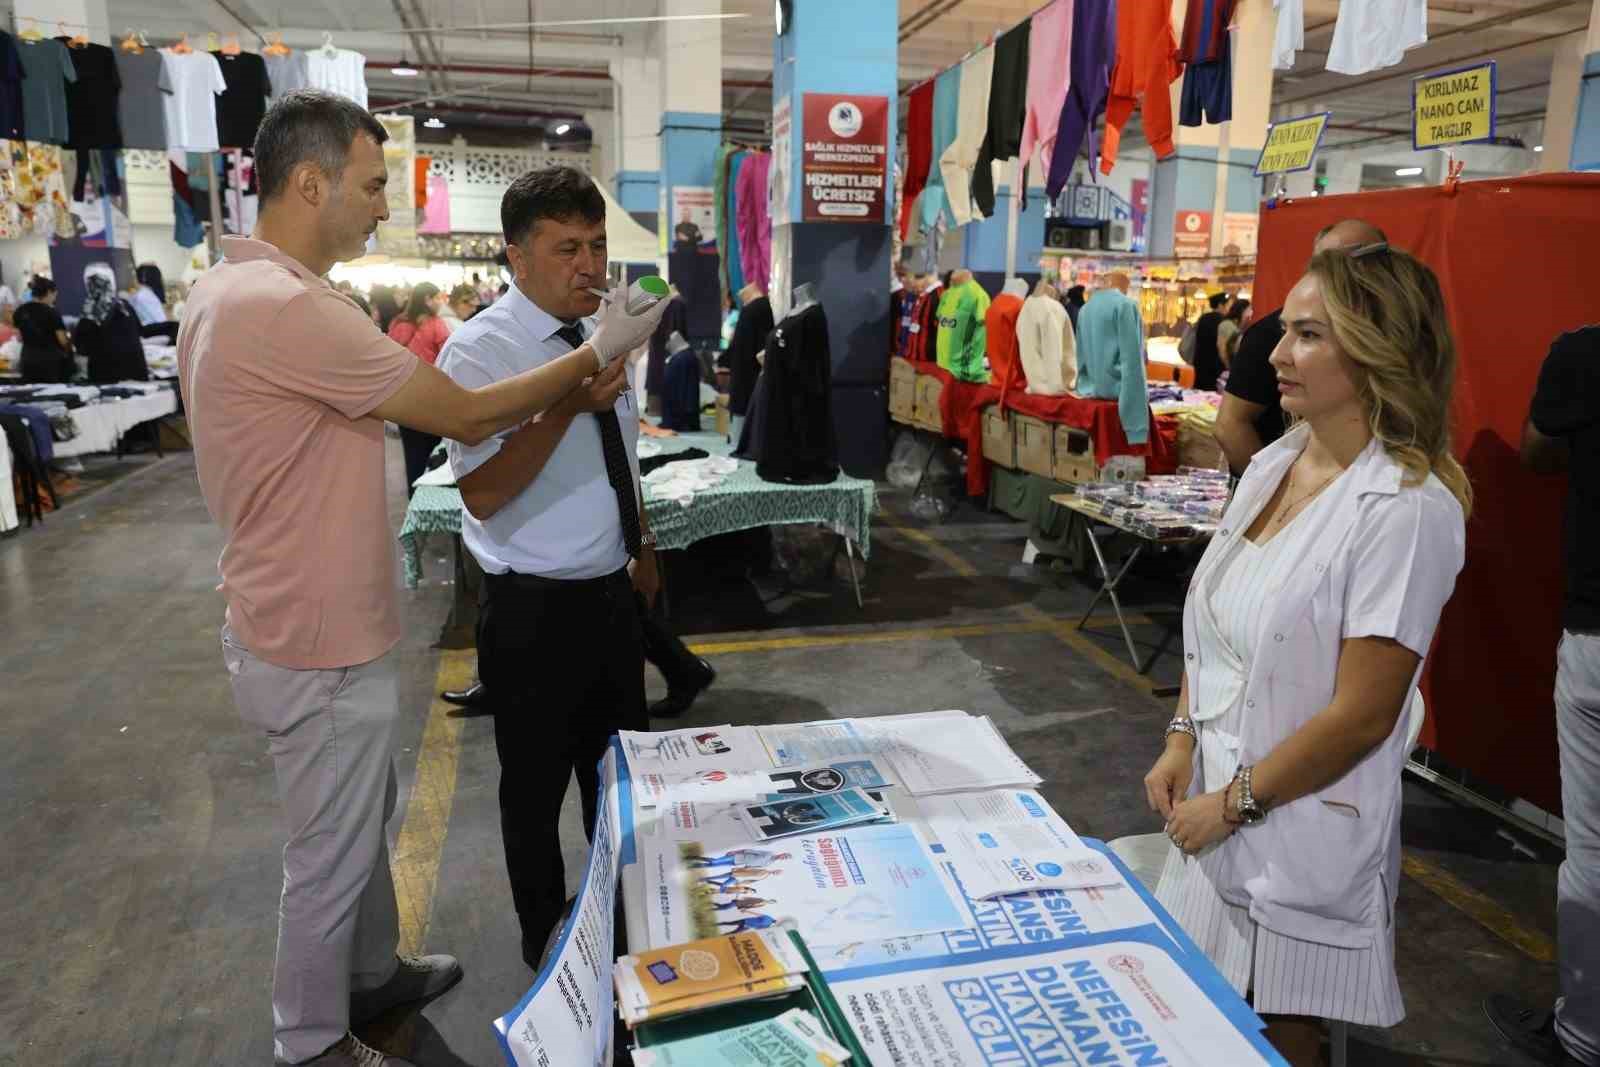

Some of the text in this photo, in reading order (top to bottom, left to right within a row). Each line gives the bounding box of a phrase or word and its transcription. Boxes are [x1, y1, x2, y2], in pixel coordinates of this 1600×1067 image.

[1424, 75, 1479, 99] KIRILMAZ
[1420, 103, 1455, 120] NANO
[1430, 121, 1472, 141] TAKILIR
[805, 141, 834, 152] SAĞLIK
[806, 173, 882, 188] HİZMETLERİ
[812, 186, 876, 203] ÜCRETSİZ
[740, 938, 765, 972] MADDE
[561, 960, 584, 1000] Bırakarak
[848, 994, 867, 1022] neden
[987, 974, 1072, 1067] HAYAT
[1026, 966, 1120, 1067] DUMAN
[1062, 959, 1168, 1067] NEFESİN
[864, 992, 907, 1067] ciddi rahatsızlıkl
